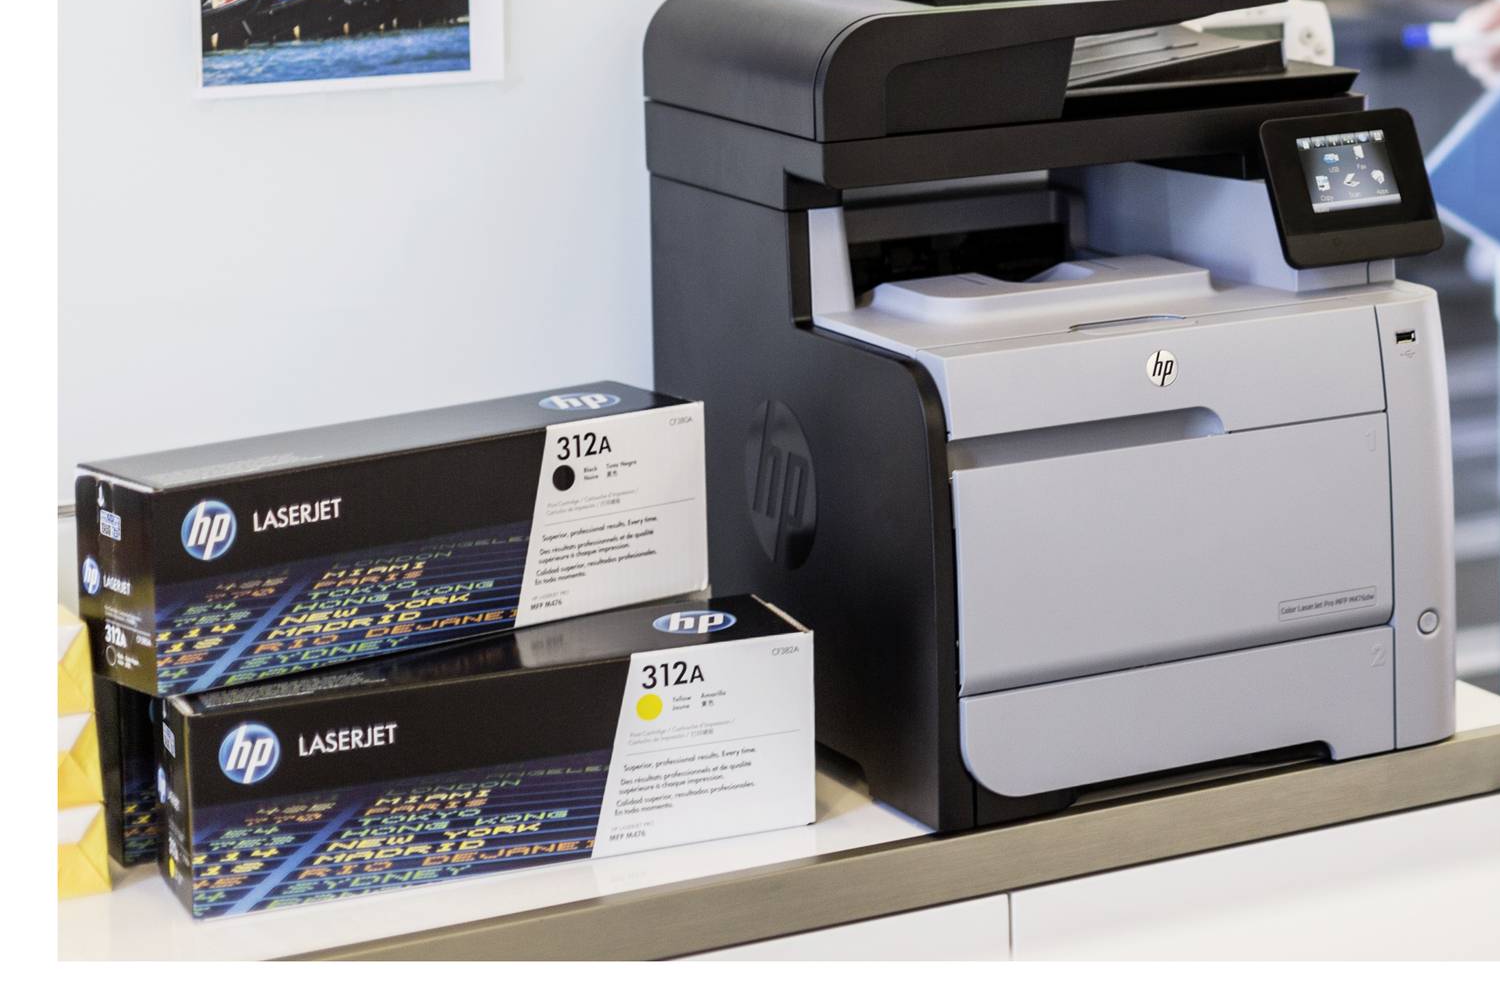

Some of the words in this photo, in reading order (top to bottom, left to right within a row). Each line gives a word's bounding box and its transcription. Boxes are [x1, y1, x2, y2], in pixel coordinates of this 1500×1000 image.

[1152, 350, 1174, 386] hp
[552, 393, 609, 410] hp
[557, 432, 612, 461] 312A
[752, 400, 809, 565] hp
[253, 498, 342, 532] LASERJET
[188, 500, 231, 561] hp
[570, 525, 605, 538] professional
[313, 570, 424, 589] PARIS
[322, 561, 427, 580] MIAMI
[536, 567, 560, 577] Calidad
[292, 593, 391, 613] HONG
[411, 580, 495, 598] KONG
[308, 581, 417, 600] TOKYO
[279, 607, 358, 626] NEW
[384, 593, 471, 612] YORK
[1281, 607, 1297, 615] Color
[1324, 600, 1335, 608] Pro
[1336, 597, 1348, 605] MFP
[105, 623, 128, 649] 312A
[267, 611, 422, 640] MADRID
[668, 612, 725, 634] hp
[240, 636, 409, 669] SYDNEY
[254, 635, 339, 654] RIO
[772, 646, 800, 657] CF382A
[642, 661, 705, 690] 312A
[298, 723, 398, 757] LASERJET
[225, 724, 275, 784] hp
[655, 755, 696, 769] professional
[721, 750, 740, 758] Every
[364, 798, 490, 816] PARIS
[375, 789, 492, 807] MIAMI
[616, 798, 643, 807] Calidad
[339, 821, 450, 840] HONG
[474, 809, 569, 827] KONG
[358, 808, 482, 827] TOKYO
[326, 834, 415, 852] NEW
[444, 823, 542, 839] YORK
[313, 839, 486, 866] MADRID
[281, 864, 472, 895] SYDNEY
[298, 861, 393, 880] RIO
